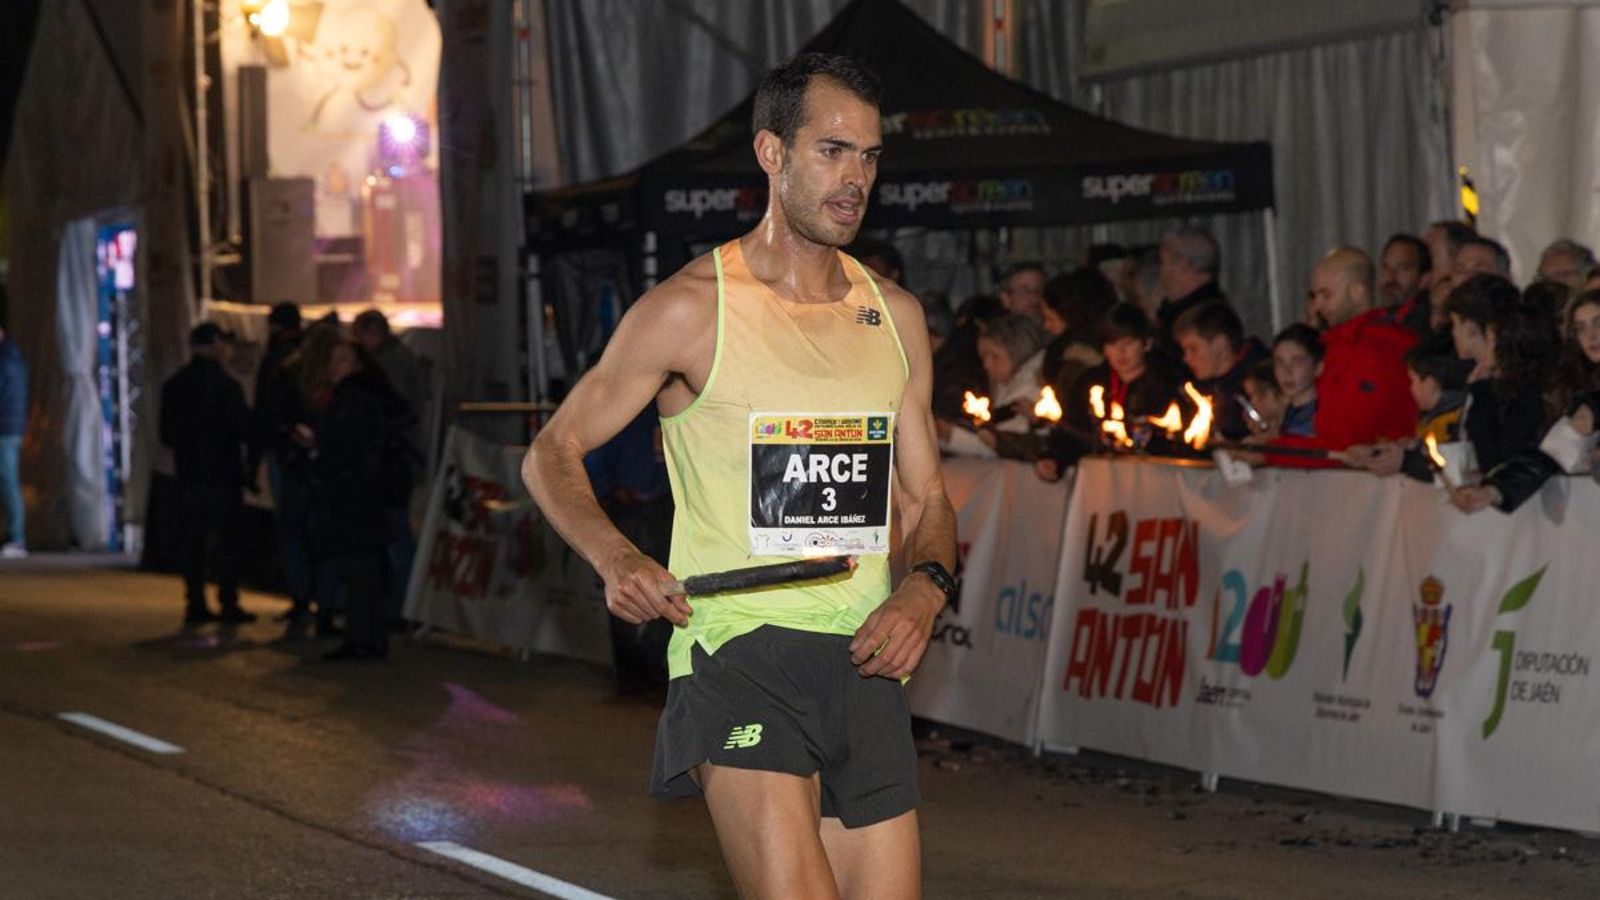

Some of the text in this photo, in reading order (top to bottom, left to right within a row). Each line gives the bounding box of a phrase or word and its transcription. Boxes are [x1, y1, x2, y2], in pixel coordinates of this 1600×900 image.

[782, 453, 868, 483] ARCE
[821, 487, 837, 511] 3
[783, 515, 815, 525] DANIEL
[817, 515, 839, 524] ARCE
[1083, 510, 1200, 609] 42 SAN
[1515, 650, 1590, 676] DIPUTACIÓN
[1510, 680, 1561, 704] DE JAÉN
